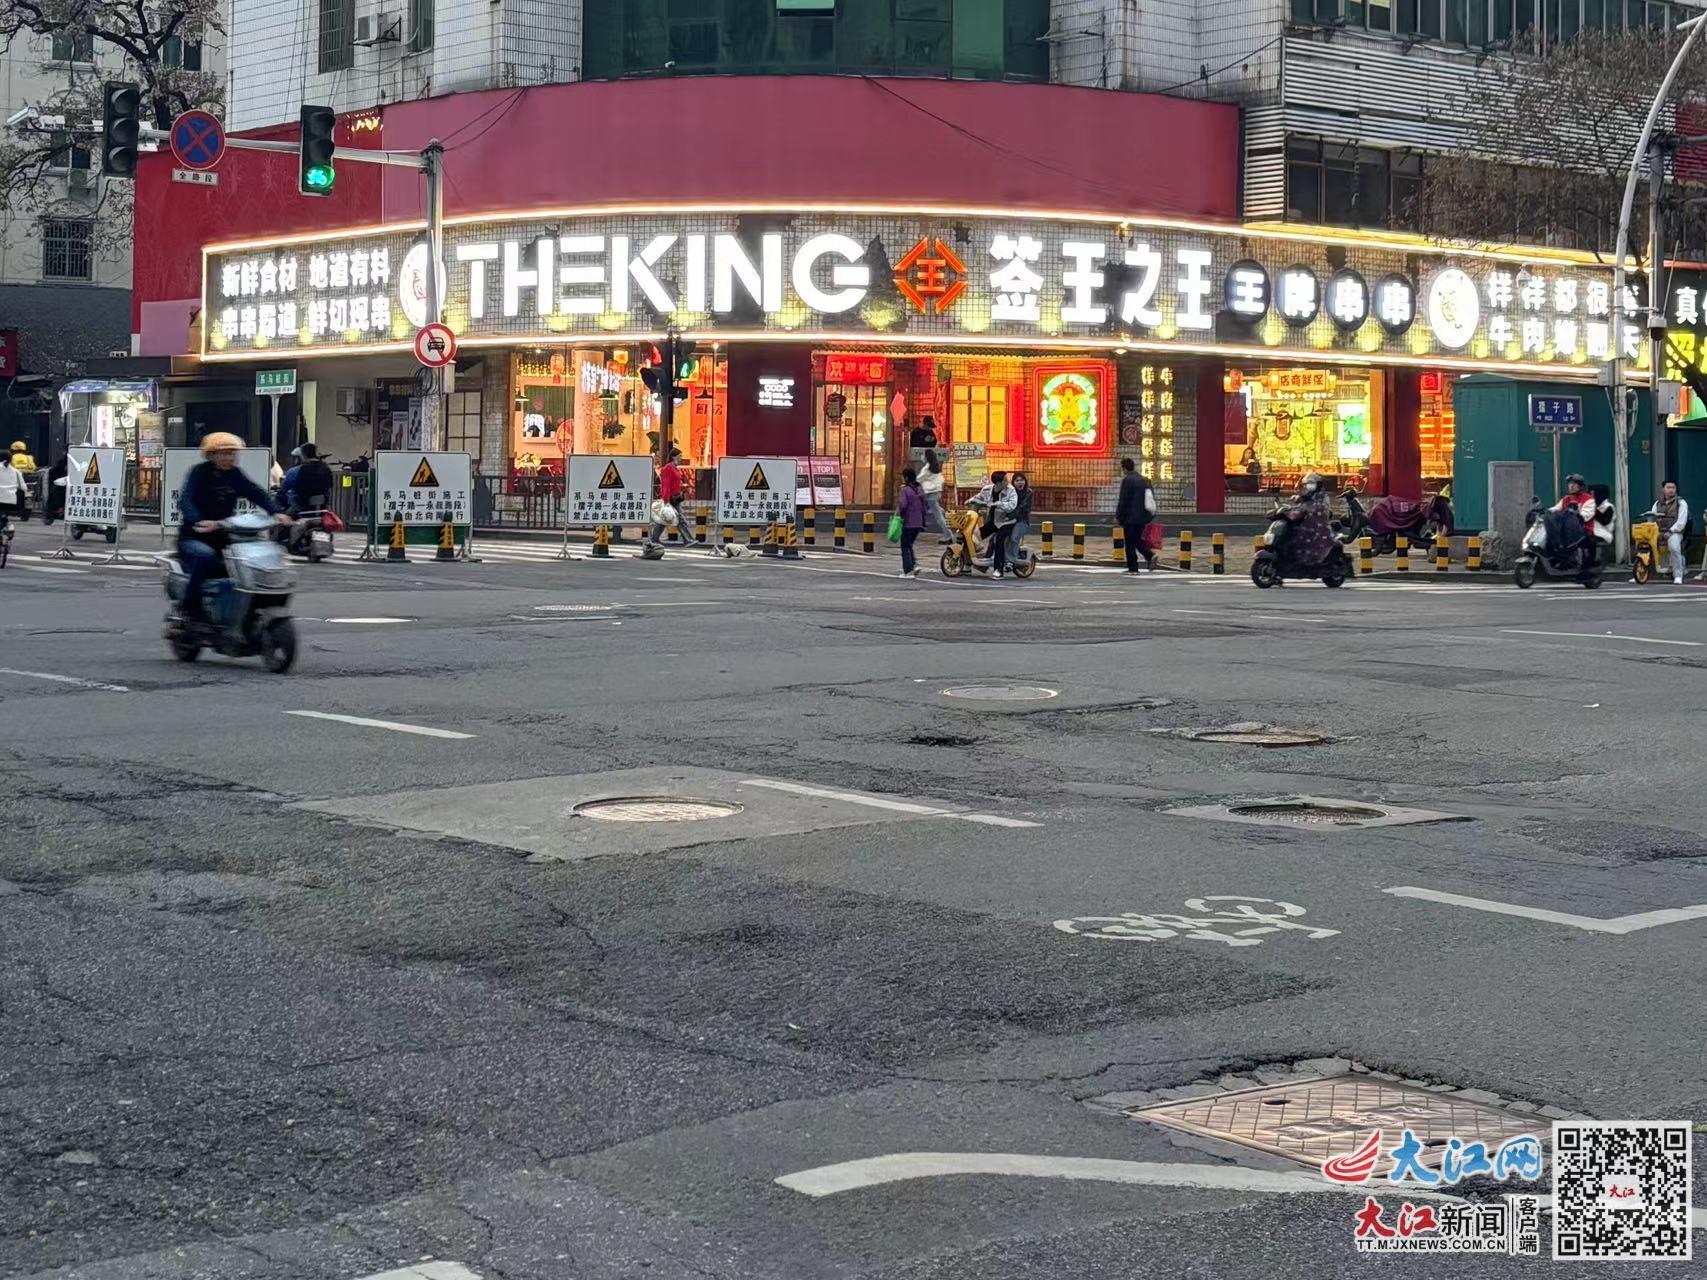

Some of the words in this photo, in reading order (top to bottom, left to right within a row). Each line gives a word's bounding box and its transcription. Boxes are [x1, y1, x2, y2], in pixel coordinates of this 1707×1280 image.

[179, 171, 212, 183] 全路段
[222, 256, 298, 297] 新鲜食材
[309, 247, 391, 289] 地道有料
[989, 234, 1212, 330] 签王之王
[817, 465, 835, 474] TOP1
[573, 511, 645, 521] 禁止由北向南通行
